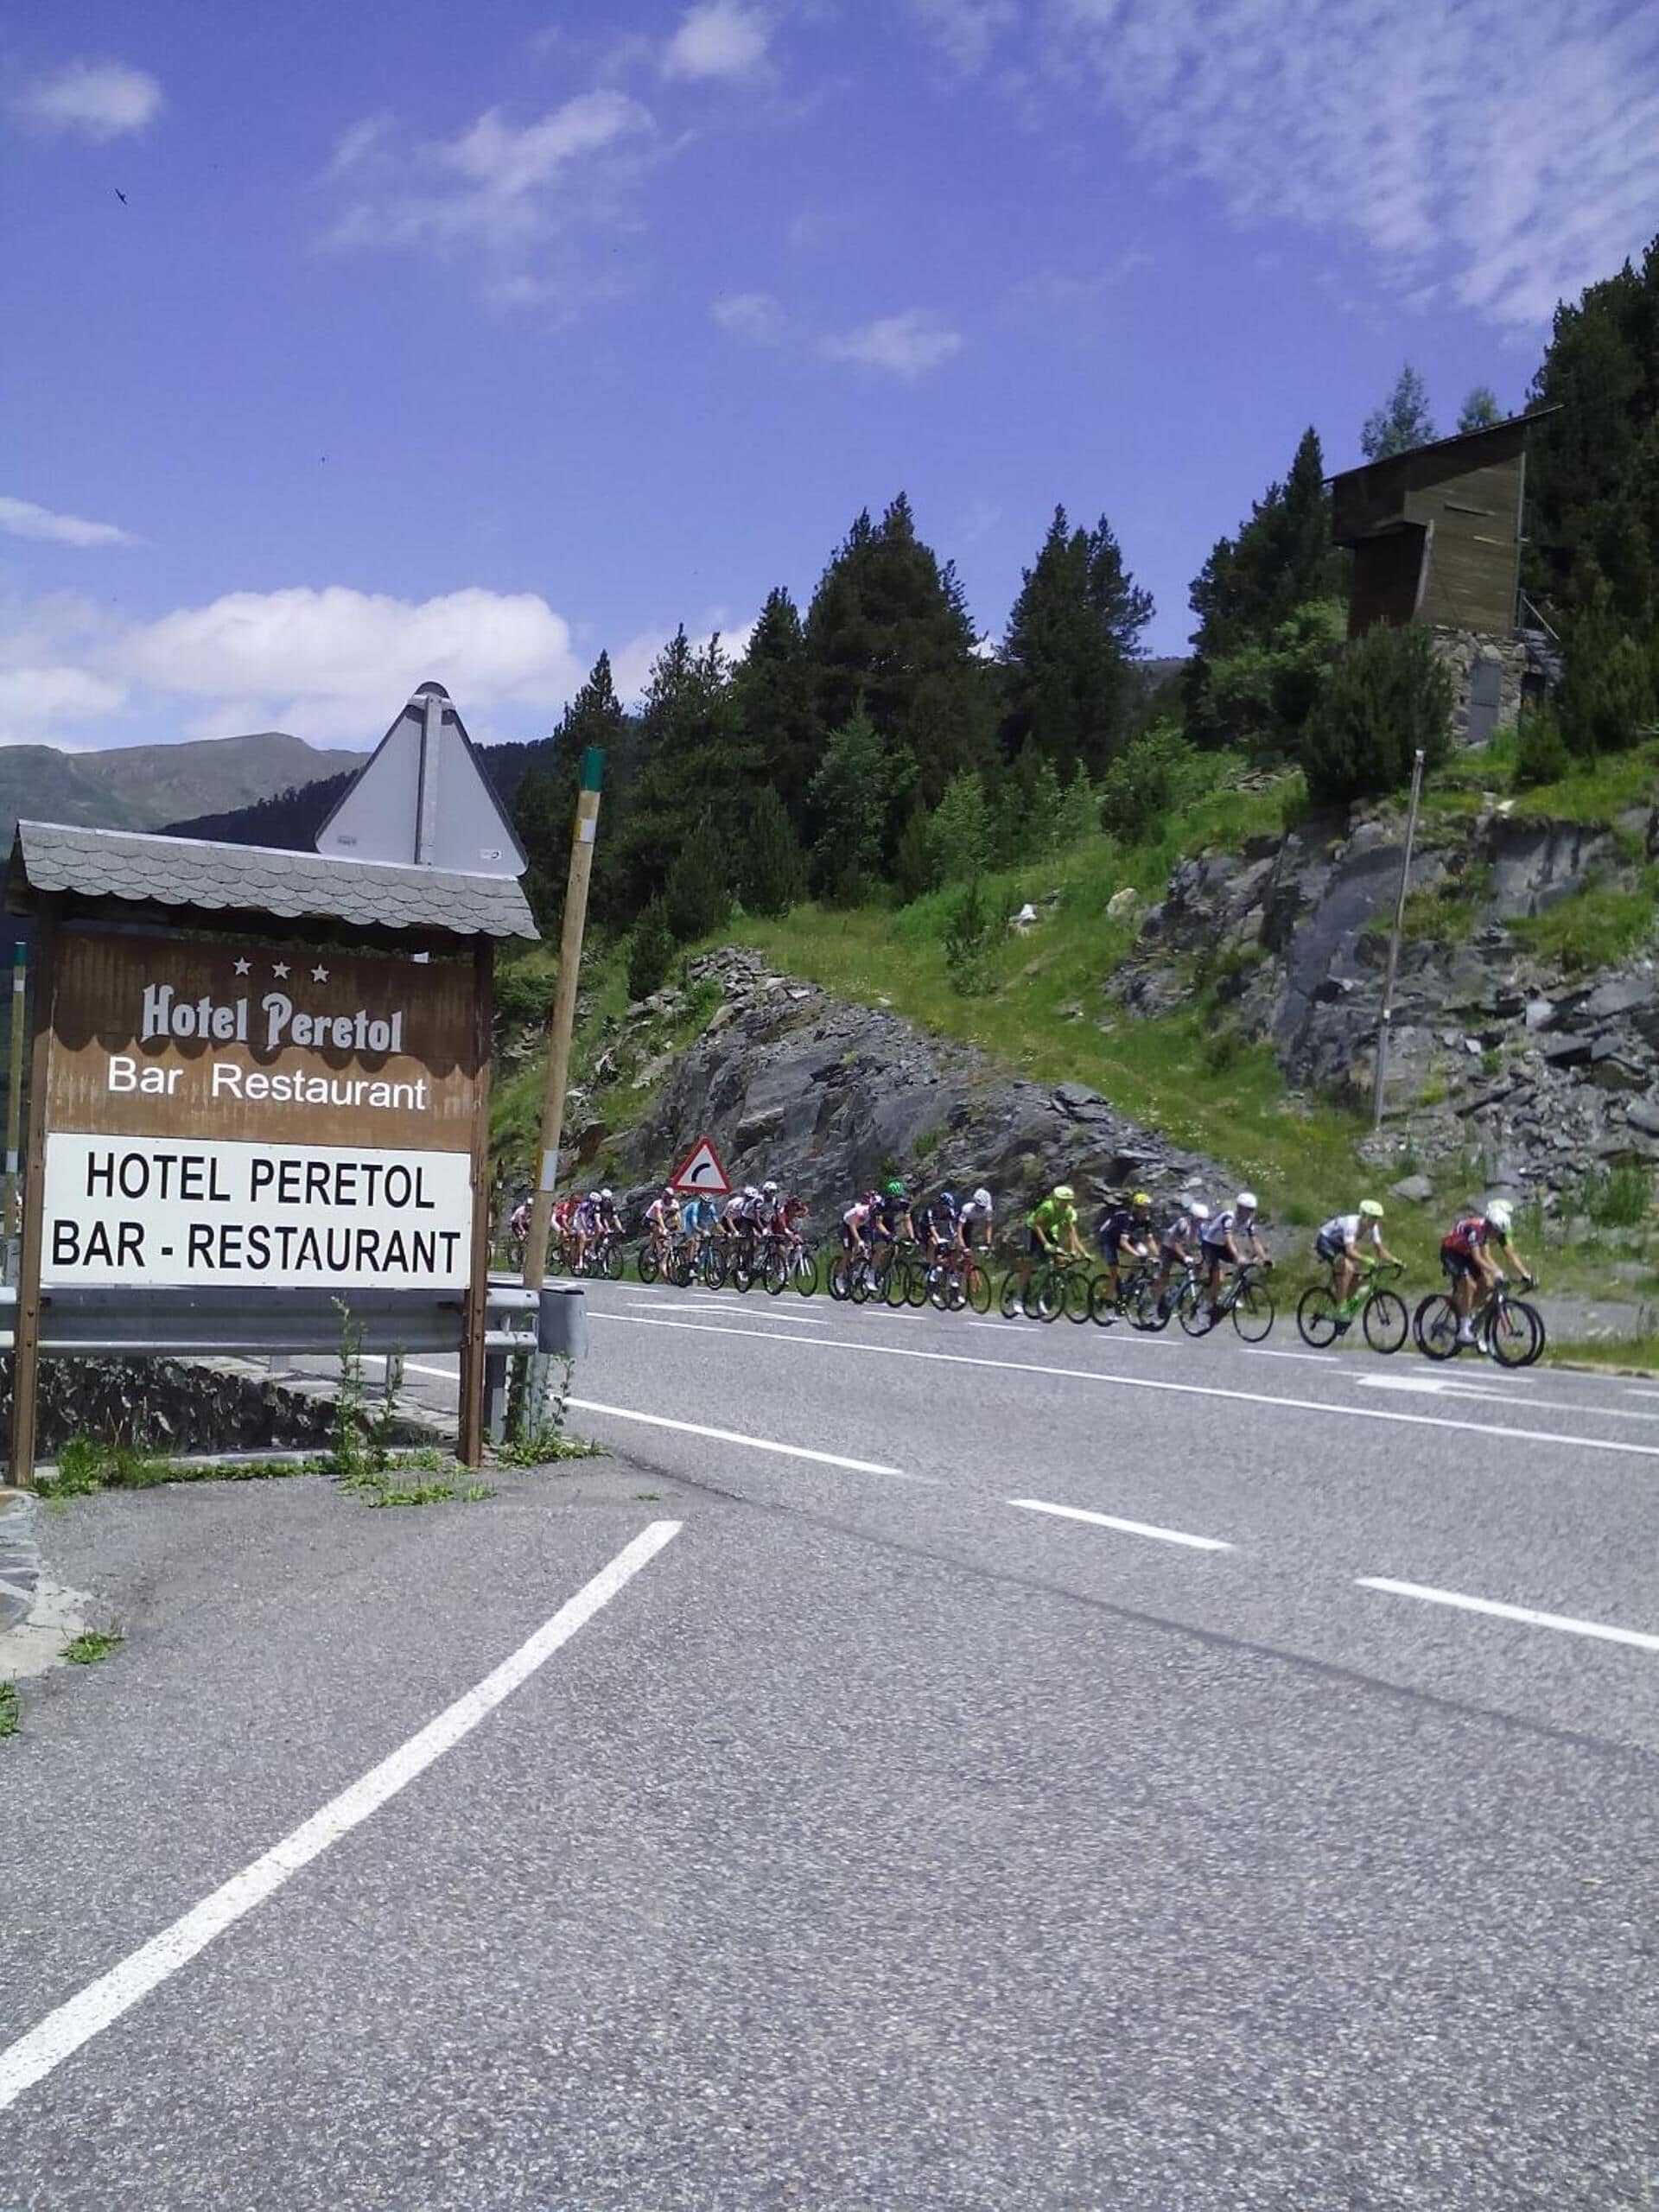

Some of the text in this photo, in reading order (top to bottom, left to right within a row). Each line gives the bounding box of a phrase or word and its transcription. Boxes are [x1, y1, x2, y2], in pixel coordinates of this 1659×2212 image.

[142, 983, 403, 1052] Hotel Peretol
[108, 1057, 427, 1110] Bar Restaurant
[86, 1152, 435, 1209] HOTEL PERETOL
[53, 1219, 145, 1268] BAR
[188, 1224, 461, 1274] RESTAURANT
